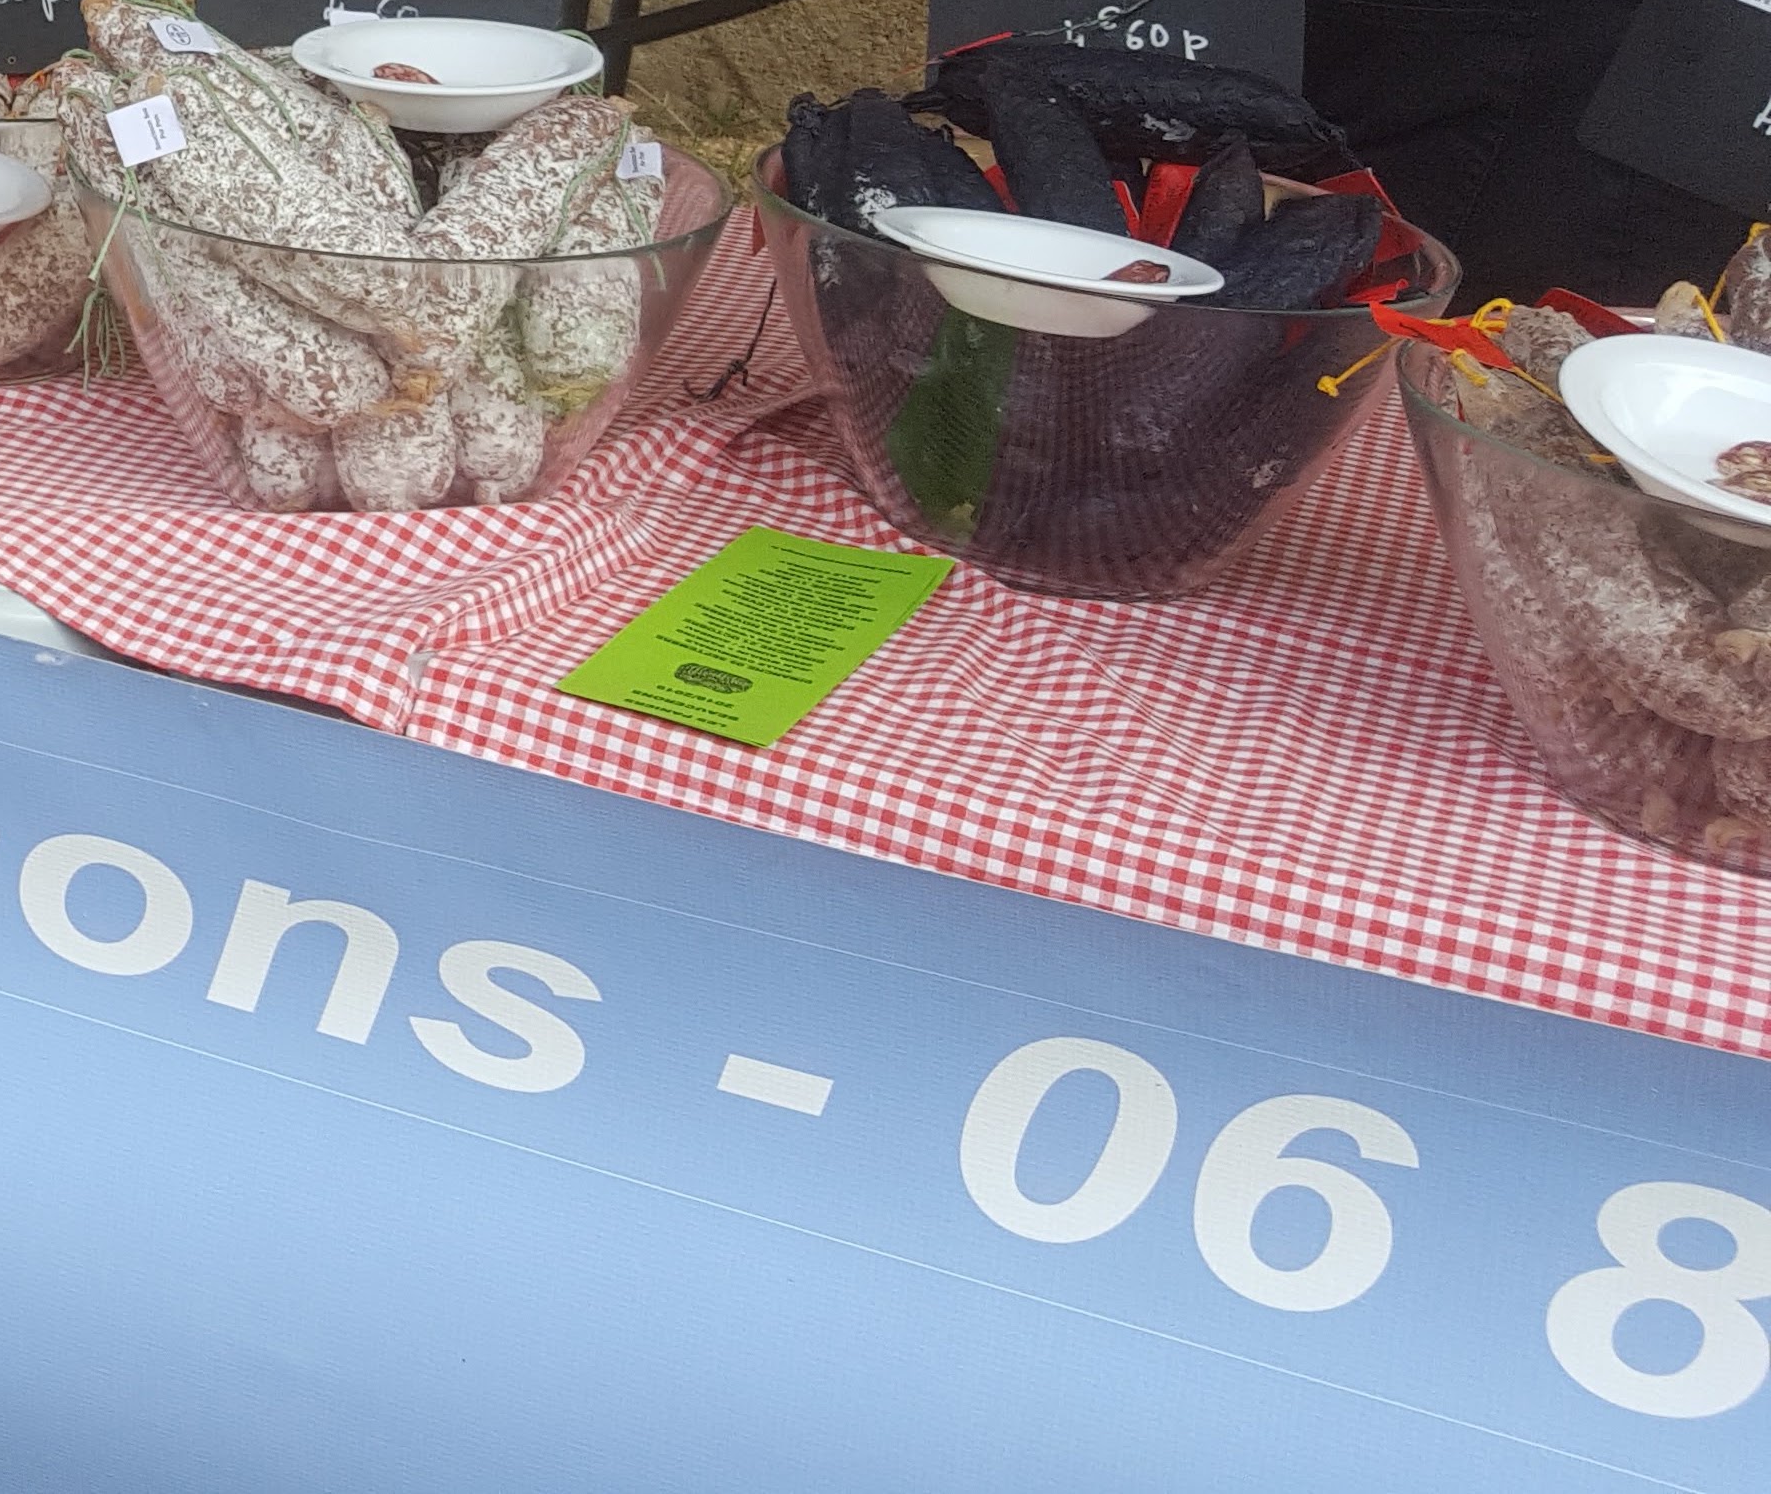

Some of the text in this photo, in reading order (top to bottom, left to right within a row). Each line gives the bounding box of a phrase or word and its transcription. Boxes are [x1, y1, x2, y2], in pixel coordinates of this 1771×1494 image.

[1182, 28, 1210, 62] p
[715, 1052, 836, 1118] -
[958, 1034, 1421, 1315] 06
[1544, 1180, 1771, 1421] 8
